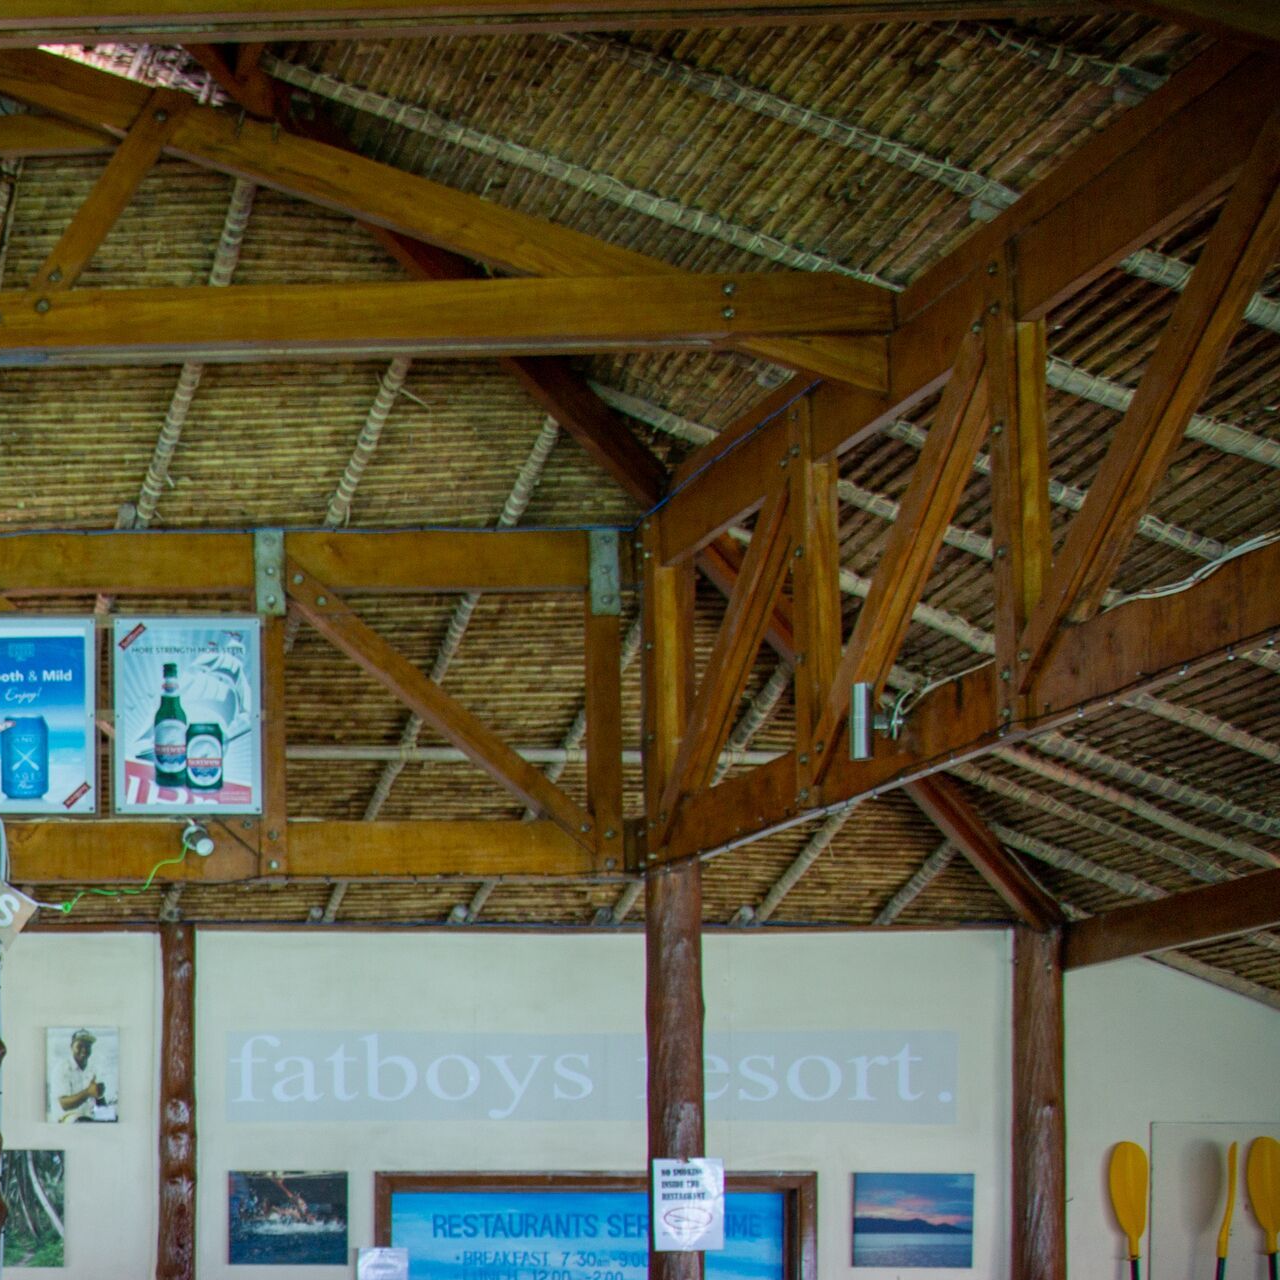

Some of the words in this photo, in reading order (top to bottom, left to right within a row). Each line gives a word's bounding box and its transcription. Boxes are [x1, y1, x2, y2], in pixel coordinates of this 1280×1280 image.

[28, 671, 38, 682] &
[42, 669, 73, 683] Mild
[229, 1034, 594, 1119] fatboys
[636, 1042, 952, 1103] esort.
[432, 1213, 598, 1239] RESTAURANTS
